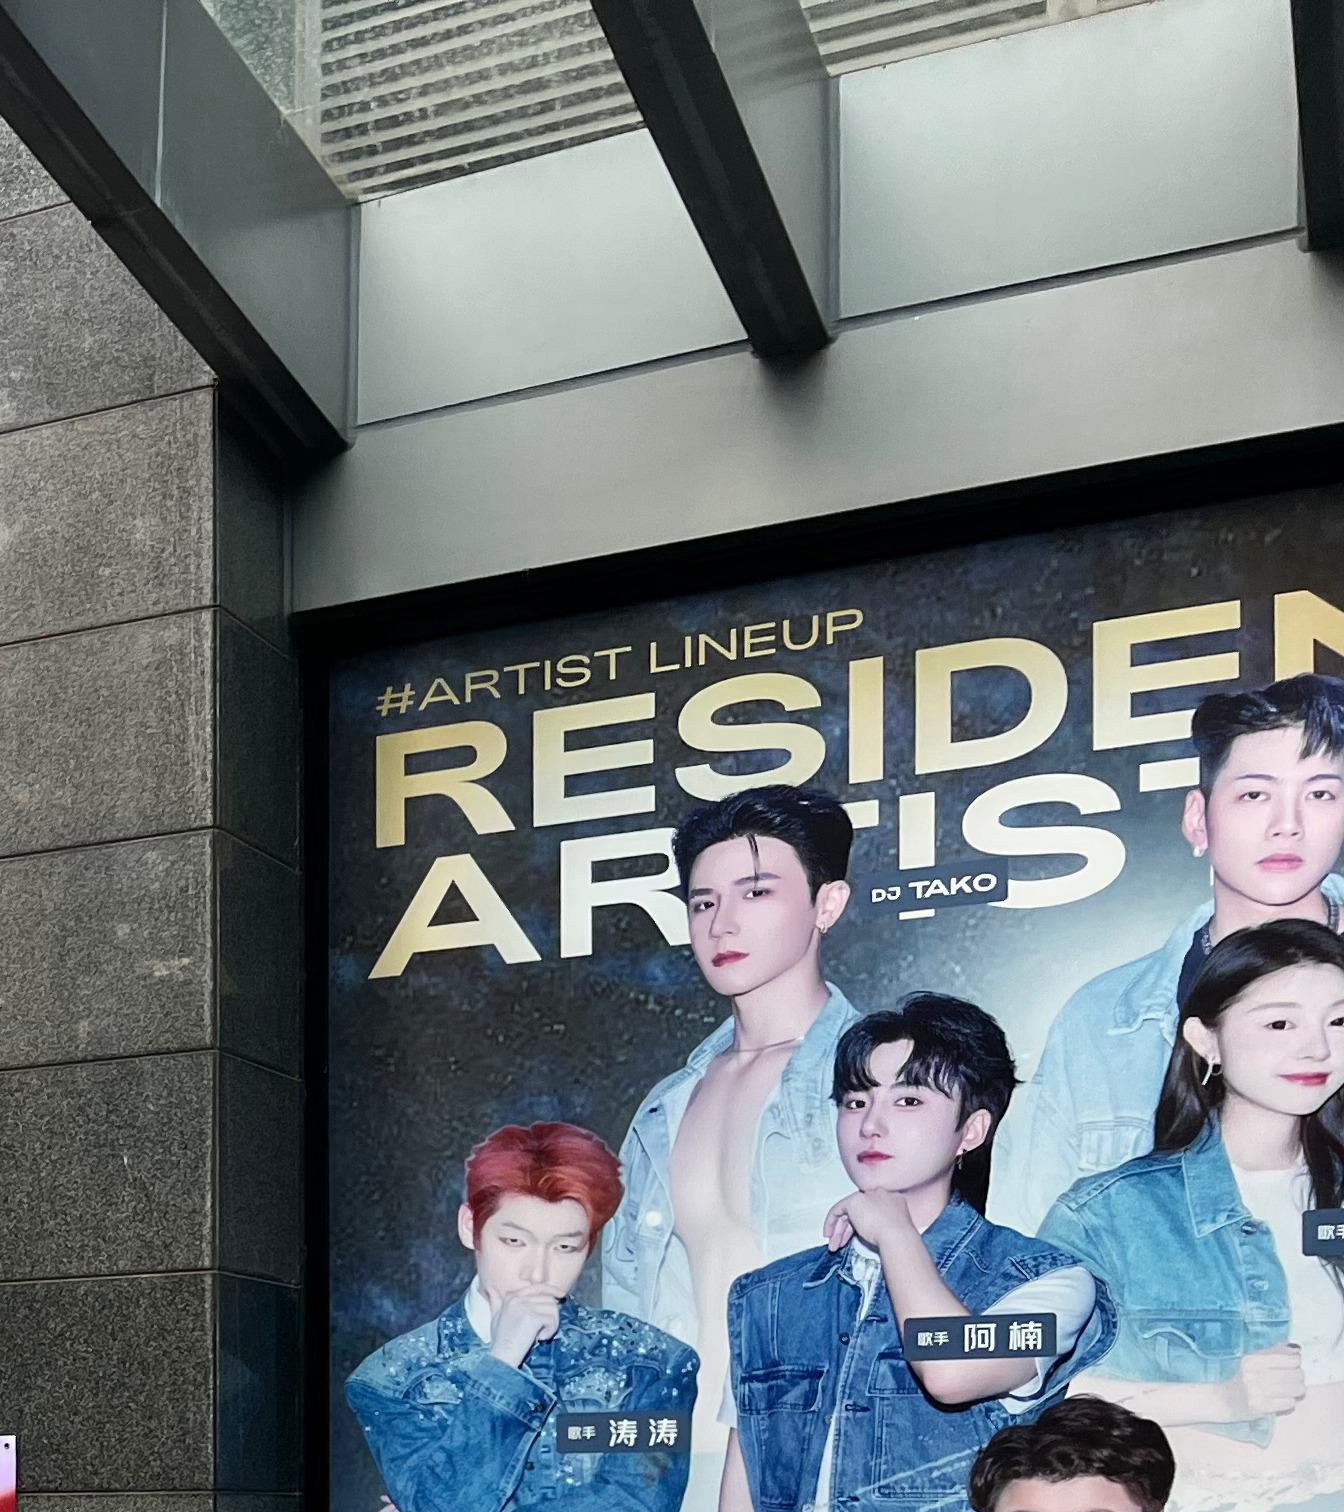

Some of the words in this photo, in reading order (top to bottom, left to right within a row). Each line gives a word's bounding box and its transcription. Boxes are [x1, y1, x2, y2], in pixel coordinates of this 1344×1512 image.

[376, 645, 632, 717] #ARTIST
[650, 608, 864, 673] LINEUP
[871, 886, 901, 903] DJ
[908, 873, 998, 899] TAKO
[917, 1331, 950, 1347] 歌手
[963, 1320, 1043, 1353] 阿楠
[567, 1425, 596, 1440] 歌手
[608, 1418, 678, 1447] 涛涛
